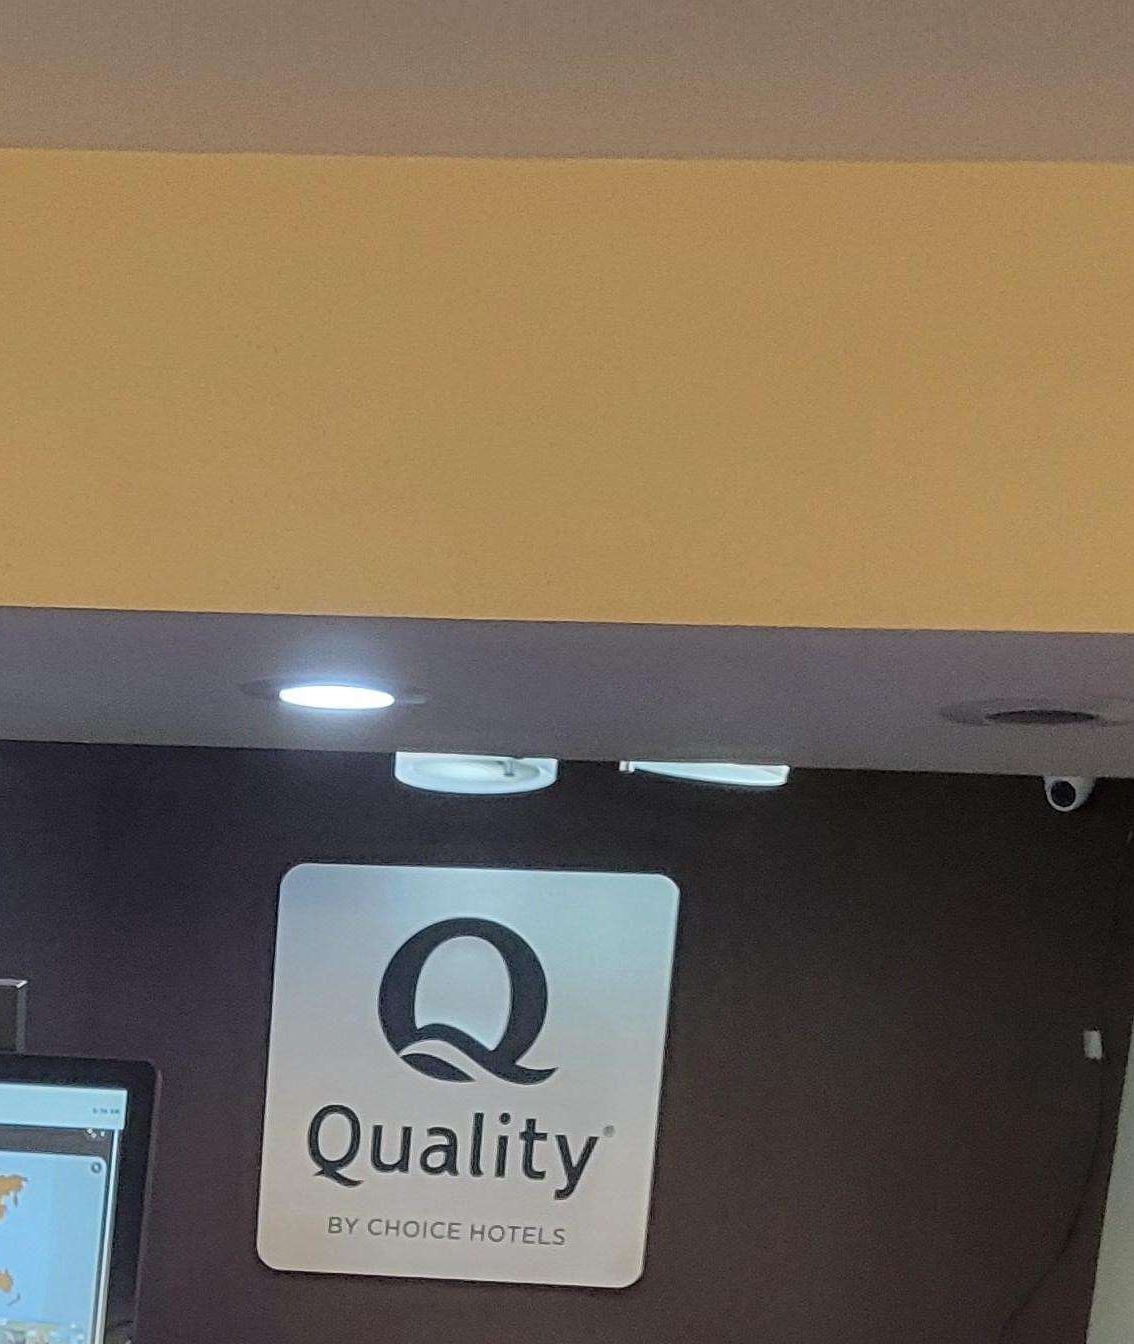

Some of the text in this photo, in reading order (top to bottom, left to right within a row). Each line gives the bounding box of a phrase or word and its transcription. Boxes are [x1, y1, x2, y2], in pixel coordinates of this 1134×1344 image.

[377, 916, 559, 1086] Q
[306, 1103, 601, 1201] Quality
[327, 1216, 567, 1246] BY CHOICE HOTELS
